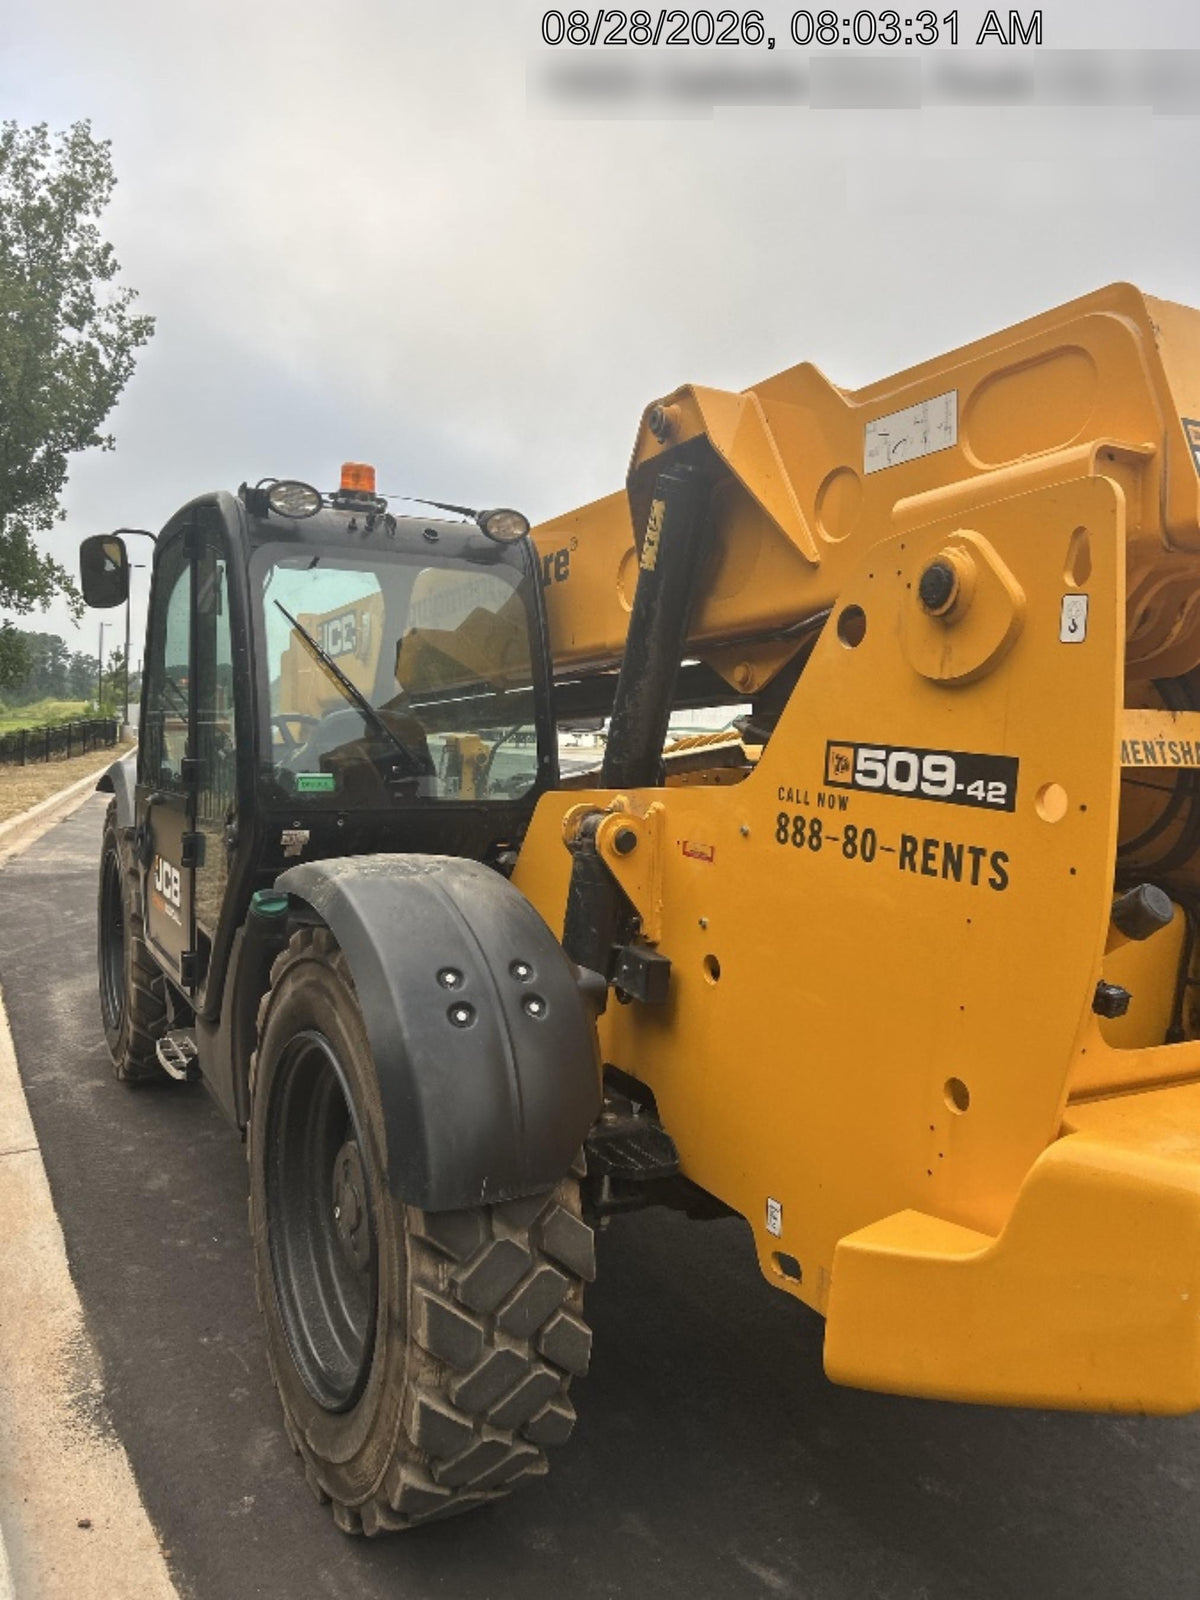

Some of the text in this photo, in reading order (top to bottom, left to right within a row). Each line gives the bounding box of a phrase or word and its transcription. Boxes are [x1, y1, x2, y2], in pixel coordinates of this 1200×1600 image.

[778, 786, 849, 812] CALL NOW
[855, 748, 1007, 804] 509-42
[776, 812, 1009, 891] 888-80-RENTS
[154, 855, 180, 907] JCB
